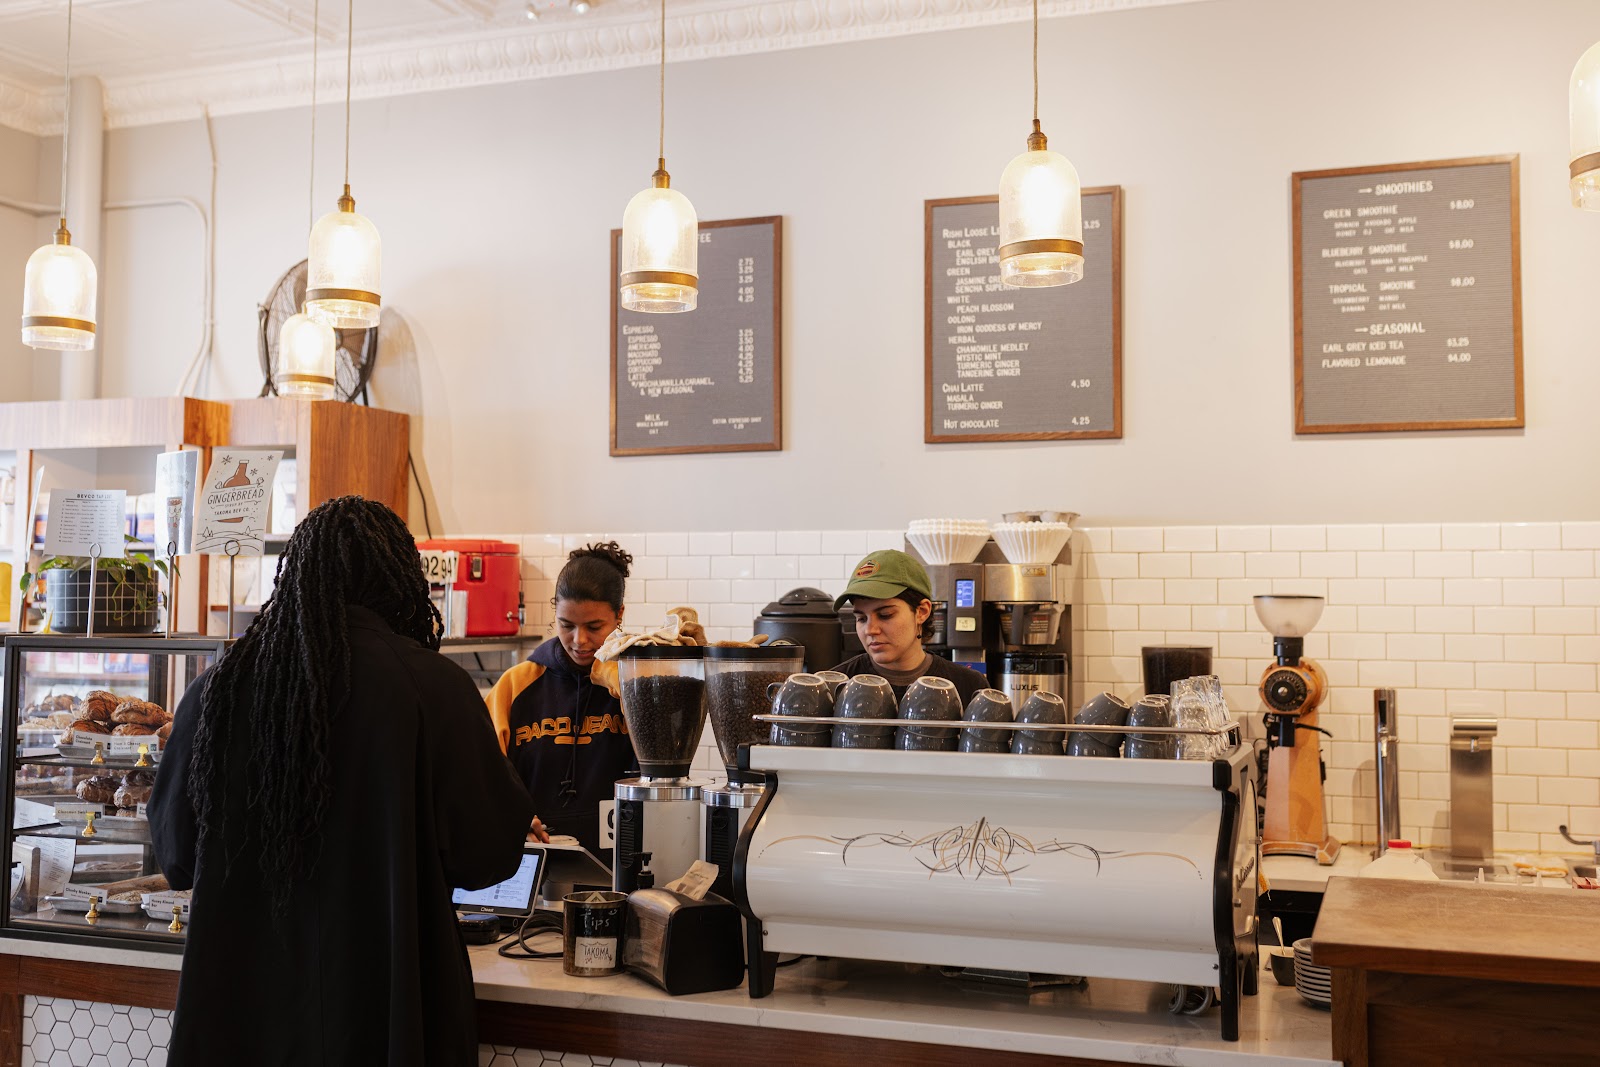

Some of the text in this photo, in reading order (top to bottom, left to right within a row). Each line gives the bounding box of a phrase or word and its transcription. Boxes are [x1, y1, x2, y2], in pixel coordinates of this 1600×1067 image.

[1375, 181, 1433, 197] SMOOTHIES
[1323, 206, 1398, 220] GREEN SMOOTHIE
[948, 240, 971, 249] BLACK
[956, 248, 996, 258] EARL GREY
[1322, 243, 1407, 258] BLUEBERRY SMOOTHIE
[956, 257, 988, 266] ENGLISH
[947, 268, 970, 277] GREEN
[956, 276, 986, 285] JASMINE
[955, 285, 983, 294] SENCHA
[1328, 280, 1416, 294] TROPICAL SMOOTHIE
[947, 296, 970, 304] WHITE
[957, 303, 1014, 314] PEACH BLOSSOM
[948, 316, 976, 324] OOLONG
[957, 322, 1042, 334] IRON GODDESS OF MERCY
[1370, 322, 1426, 336] SEASONAL
[948, 336, 976, 345] HERBAL
[957, 343, 1029, 354] CHAMOMILE MEDLEY
[1323, 340, 1404, 354] EARL GREY ICED TEA
[956, 353, 1002, 362] MYSTIC MINT
[1322, 356, 1406, 368] FLAVORED LEMONADE
[957, 360, 1020, 370] TURMERIC GINGER
[628, 373, 647, 382] LATTE
[958, 368, 1020, 378] TANGERINE GINGER
[961, 382, 984, 392] LATTE
[1071, 380, 1090, 389] 4.50
[947, 394, 974, 403] MASALA
[947, 401, 1003, 411] TURMERIC GINGER
[960, 420, 1000, 429] CHOCOLATE
[1072, 416, 1090, 426] 4.25
[208, 488, 264, 505] GINGERBREAD
[1010, 683, 1039, 691] LUXUS
[516, 716, 572, 746] PACO
[584, 945, 610, 958] TAKOMA
